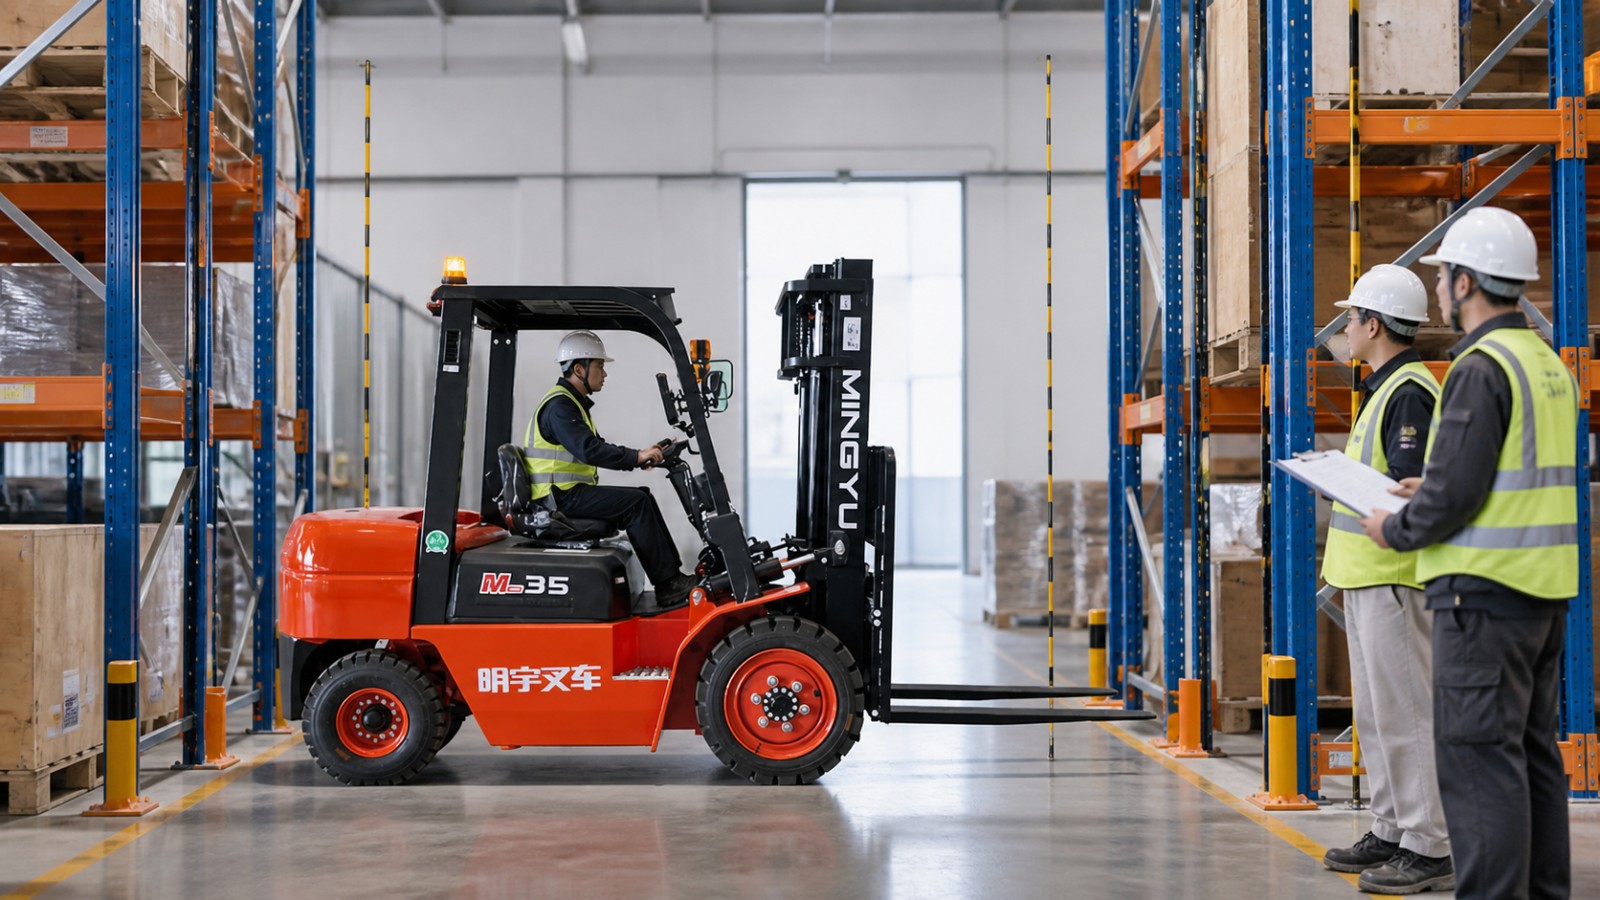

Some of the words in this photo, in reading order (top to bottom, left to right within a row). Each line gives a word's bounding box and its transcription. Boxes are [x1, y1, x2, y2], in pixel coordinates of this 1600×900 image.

[838, 369, 862, 529] MINGYU
[477, 664, 602, 694] 明宇叉车
